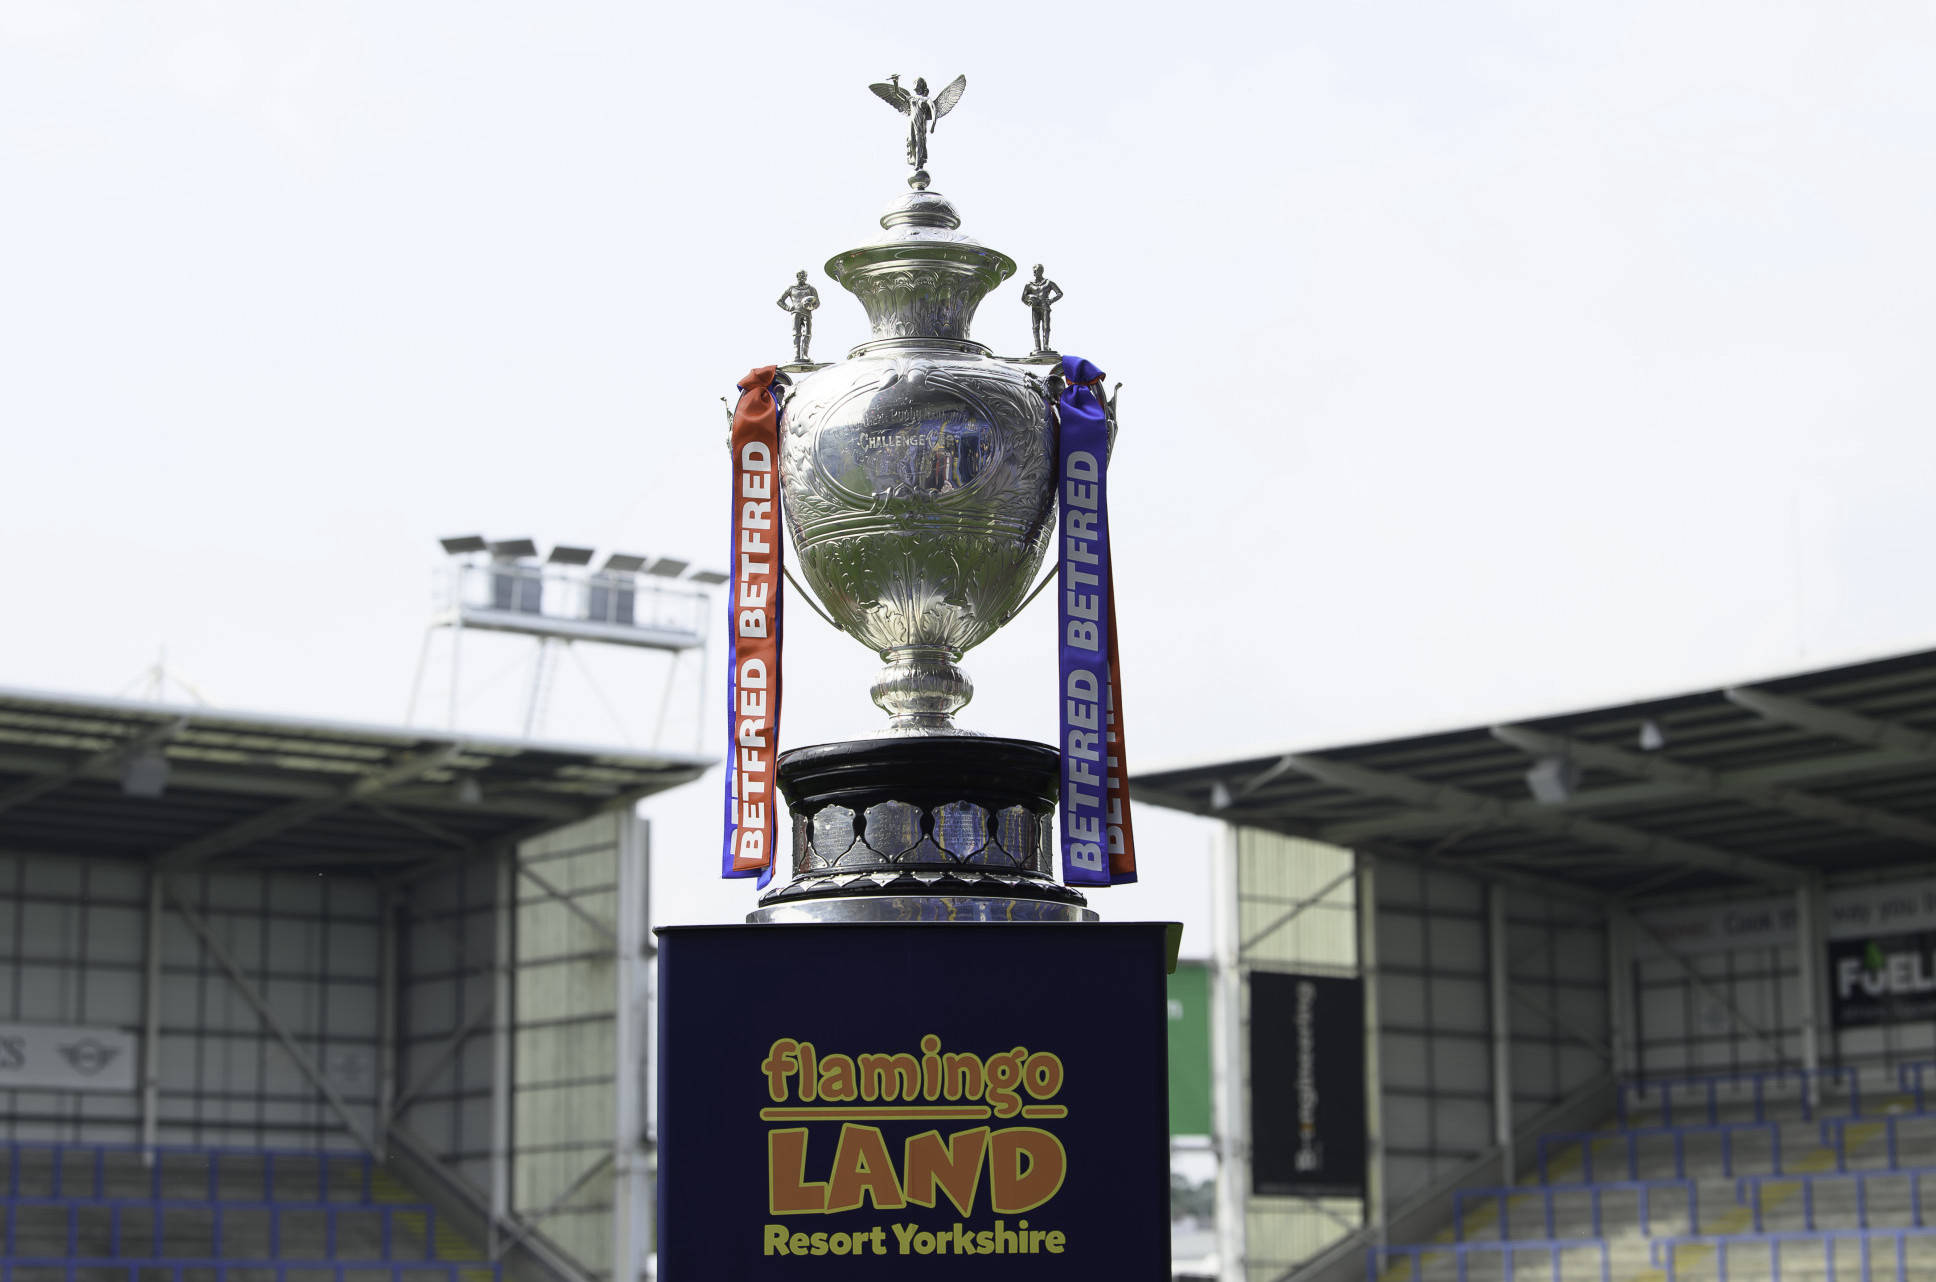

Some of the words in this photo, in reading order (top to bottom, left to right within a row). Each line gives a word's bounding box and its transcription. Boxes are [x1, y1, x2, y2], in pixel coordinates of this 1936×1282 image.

[860, 432, 926, 452] CHALLENGE
[739, 441, 772, 638] BETFRED
[1066, 451, 1099, 652] BETFRED
[740, 658, 767, 860] BETFRED
[1067, 669, 1102, 872] BETFRED
[1838, 950, 1936, 998] FUEL
[761, 1034, 1064, 1118] flamingo
[768, 1122, 1067, 1218] LAND
[764, 1224, 888, 1256] Resort
[891, 1219, 1066, 1255] Yorkshire
